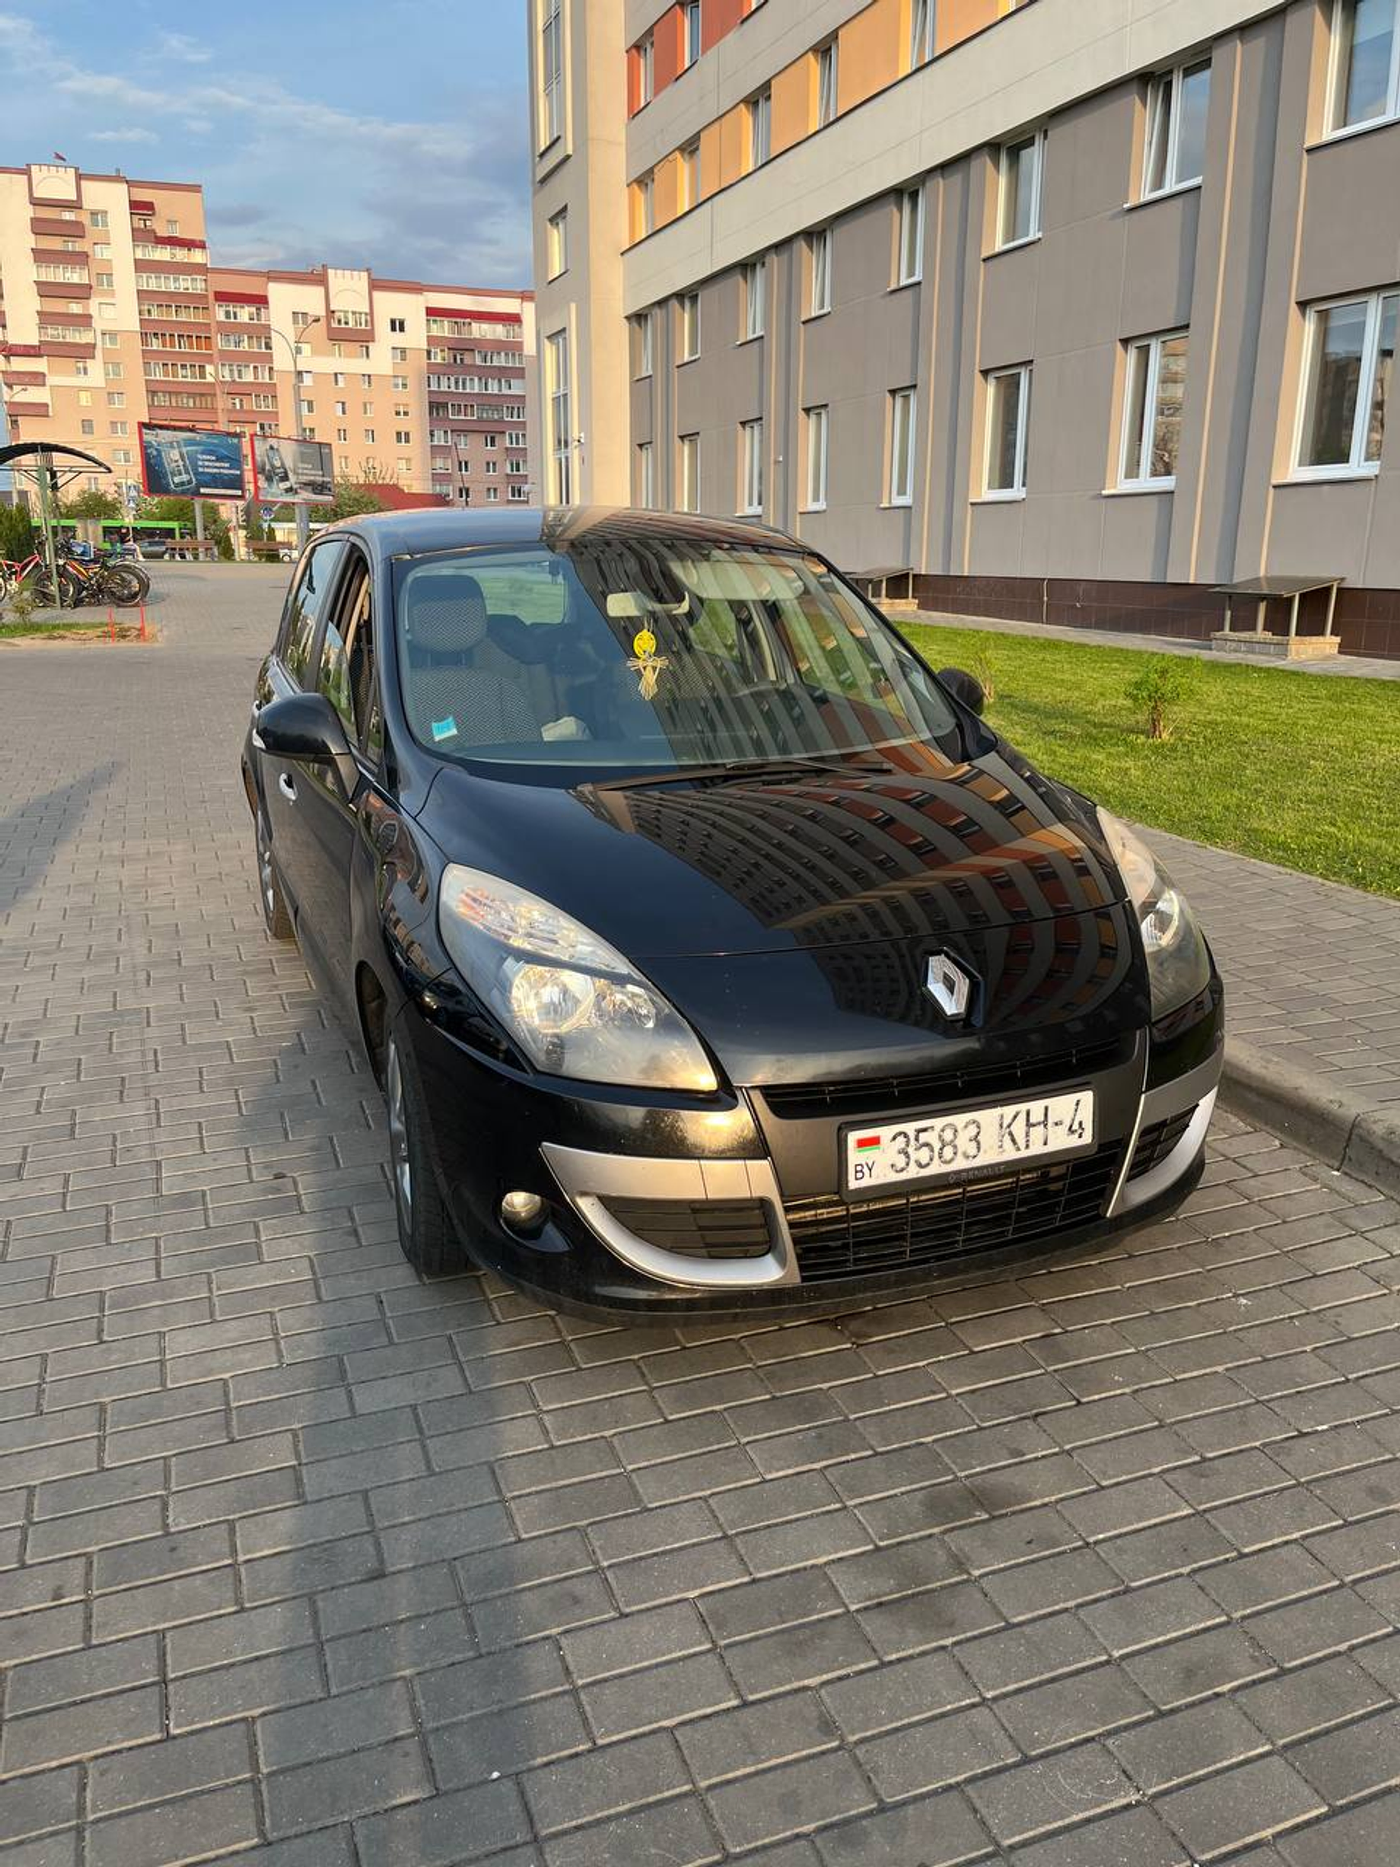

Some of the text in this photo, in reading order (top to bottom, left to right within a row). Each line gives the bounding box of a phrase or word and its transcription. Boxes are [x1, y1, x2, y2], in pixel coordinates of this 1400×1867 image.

[890, 1099, 1085, 1174] 3583 KH-4
[854, 1161, 876, 1181] BY
